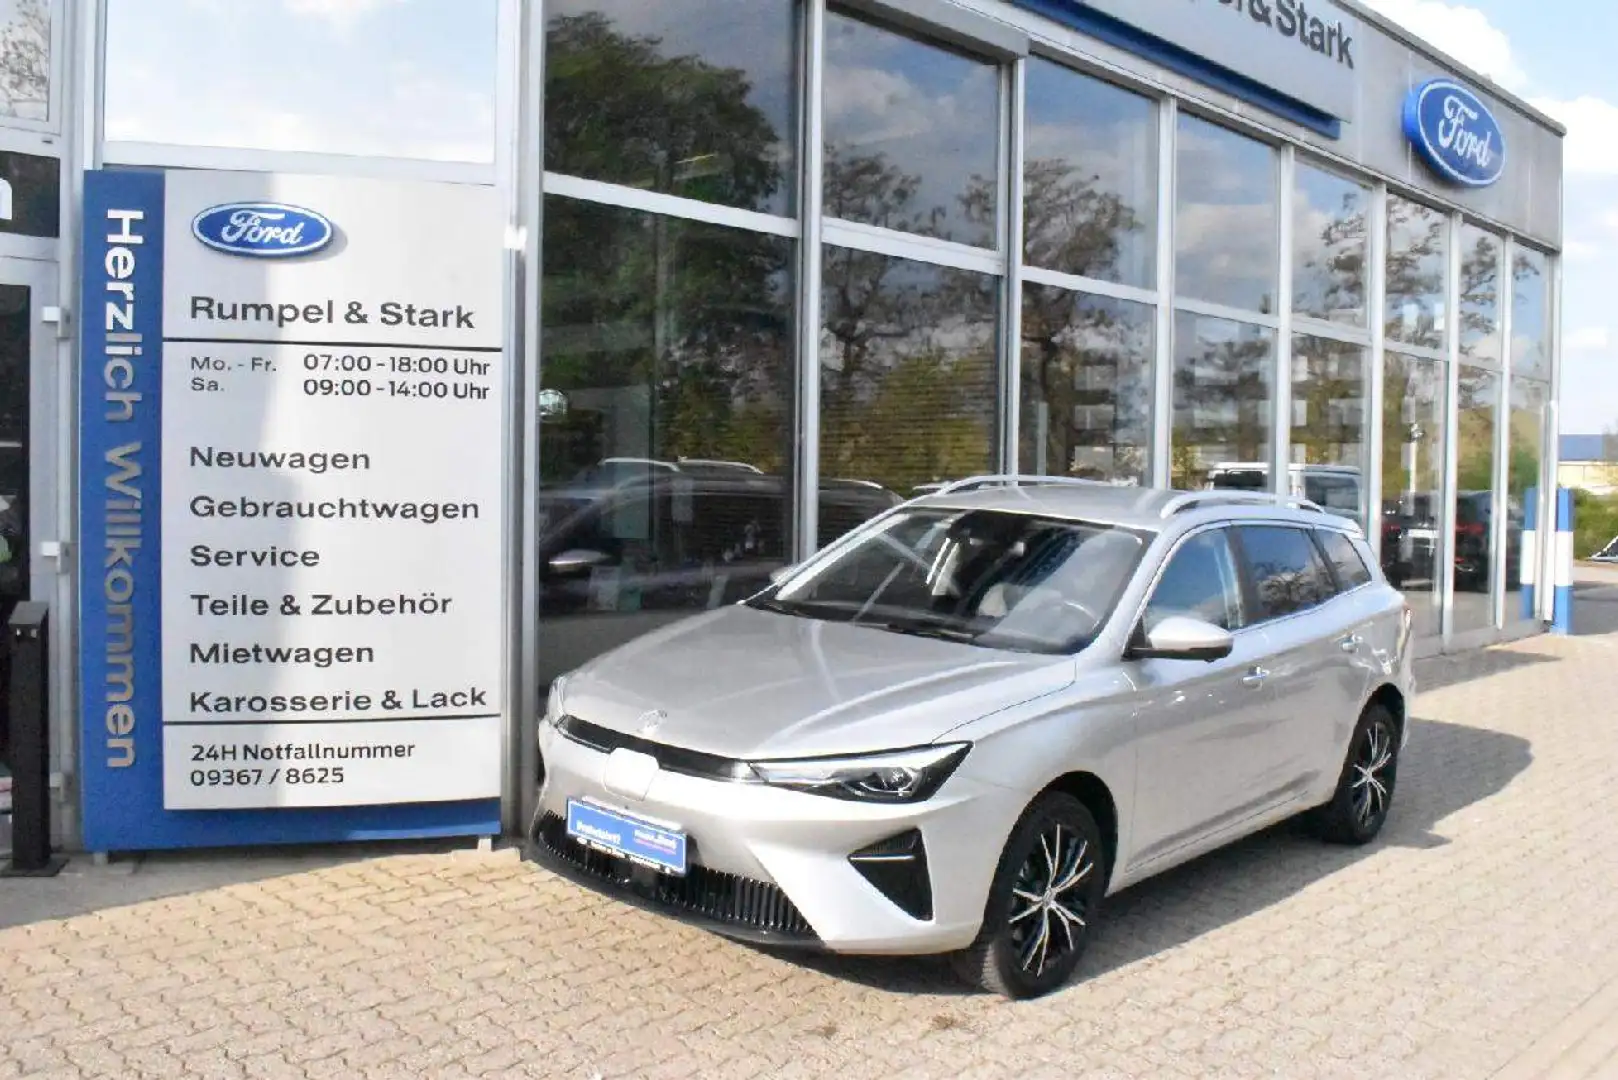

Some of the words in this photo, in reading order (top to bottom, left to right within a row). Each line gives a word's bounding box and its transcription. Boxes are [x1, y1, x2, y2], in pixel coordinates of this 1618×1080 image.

[1438, 94, 1492, 168] Ford
[221, 209, 305, 245] Ford
[104, 208, 144, 421] Herzlich
[190, 295, 334, 329] Rumpel
[343, 301, 369, 325] &
[380, 302, 476, 329] Stark
[189, 356, 232, 372] Mo.
[251, 356, 277, 373] Fr.
[303, 353, 372, 372] 07:00
[389, 356, 449, 375] 18:00
[453, 357, 491, 376] Uhr
[190, 376, 225, 392] Sa.
[303, 378, 372, 396] 09:00
[387, 380, 449, 398] 14:00
[452, 381, 491, 400] Uhr
[190, 446, 370, 475] Neuwagen
[189, 495, 479, 525] Gebrauchtwagen
[190, 544, 320, 568] Service
[104, 441, 142, 768] Willkommen
[190, 594, 270, 616] Teile
[279, 594, 302, 616] &
[310, 591, 453, 616] Zubehör
[190, 642, 374, 669] Mietwagen
[190, 690, 372, 714] Karosserie
[380, 689, 404, 711] &
[412, 686, 487, 709] Lack
[191, 743, 237, 762] 24H
[242, 742, 416, 762] Notfallnummer
[189, 768, 264, 787] 09367
[285, 766, 344, 785] 8625
